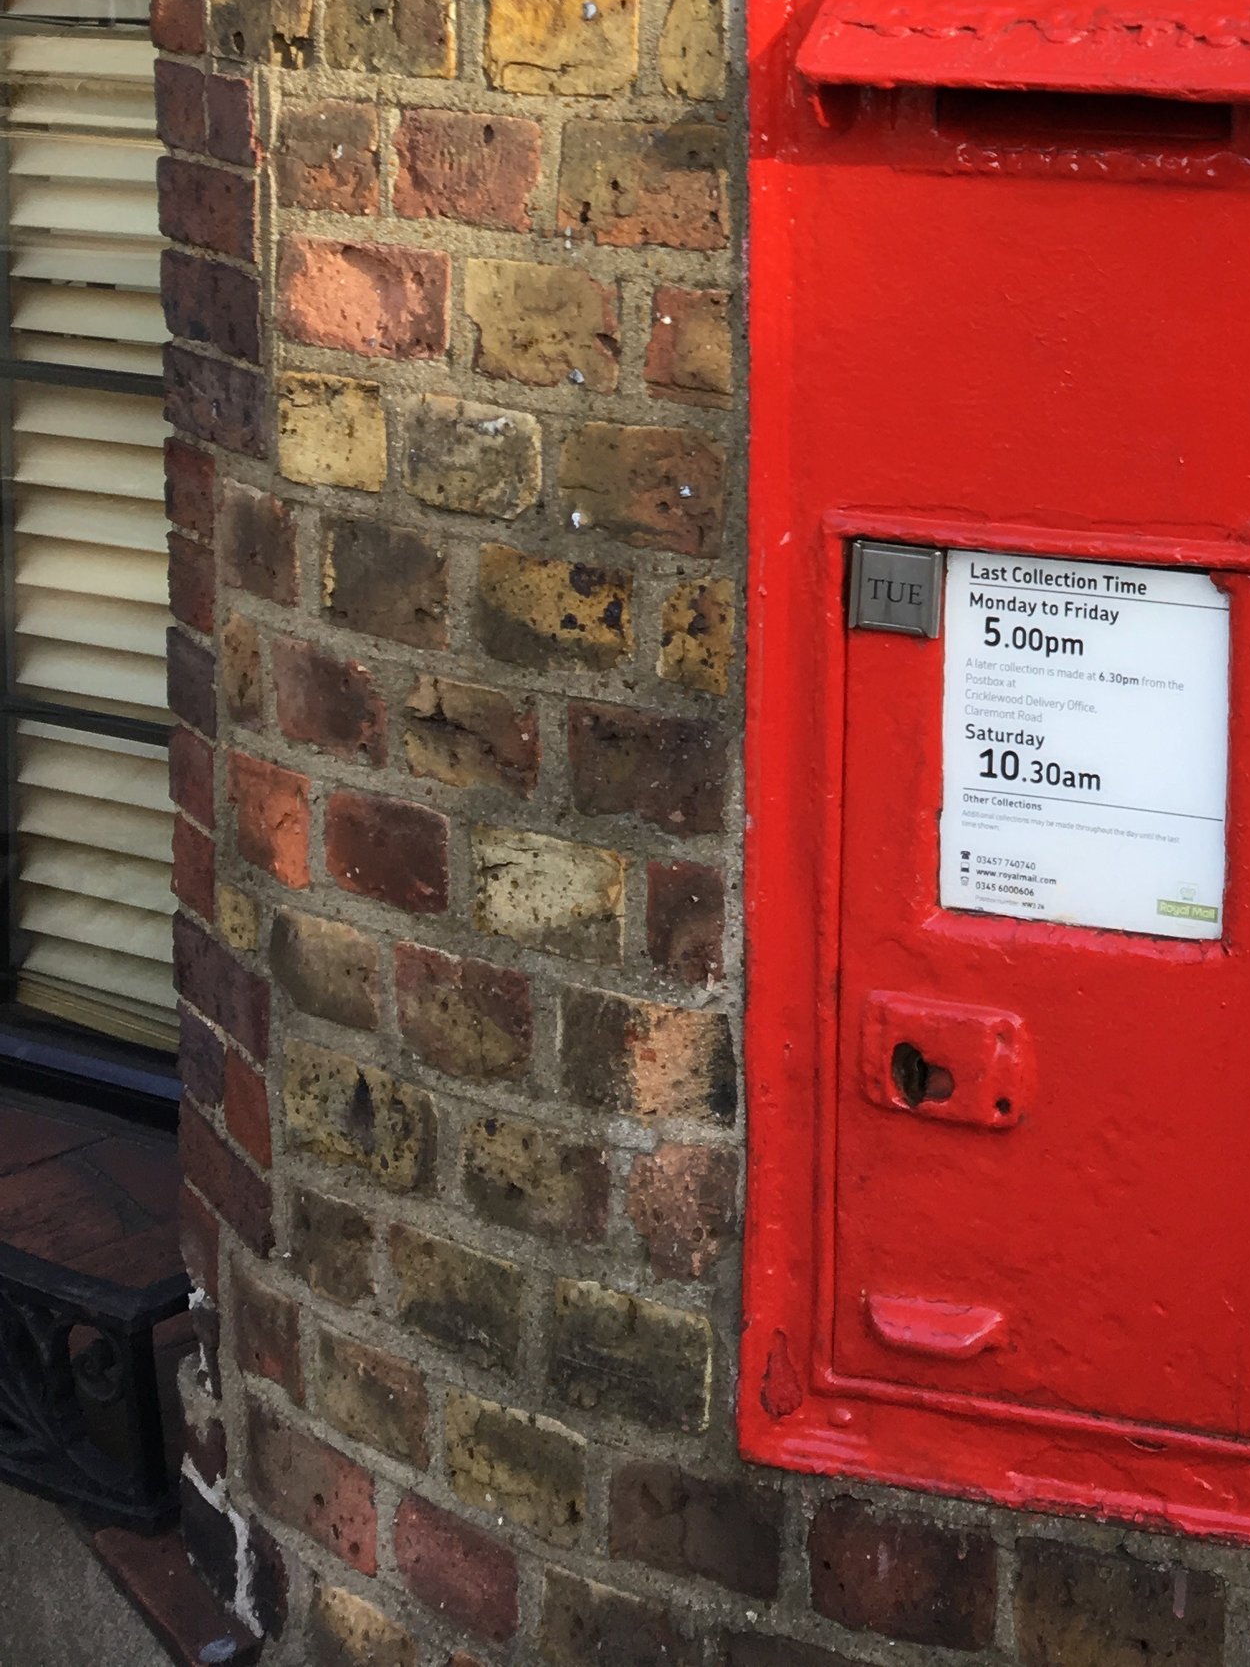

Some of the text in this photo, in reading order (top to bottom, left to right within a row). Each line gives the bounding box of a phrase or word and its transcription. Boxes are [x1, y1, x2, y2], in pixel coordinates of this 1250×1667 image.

[867, 577, 923, 606] TUE
[970, 563, 1147, 595] Last Collection Time
[969, 592, 1119, 625] Monday to Friday
[984, 616, 1084, 657] 5.00pm
[966, 658, 1185, 692] A later collection is made at 6.30pm from the
[966, 673, 1017, 688] Postbox at
[965, 688, 1024, 705] Cricklewood
[1025, 695, 1066, 711] Delivery
[964, 705, 1043, 723] Claremont Road
[965, 723, 1045, 750] Saturday
[979, 748, 1101, 791] 10.30am
[962, 793, 1043, 811] Other Collections
[976, 855, 1036, 871] 03457 740740
[975, 869, 1057, 885] www.royalmail.com
[975, 881, 1035, 896] 0345 6000606
